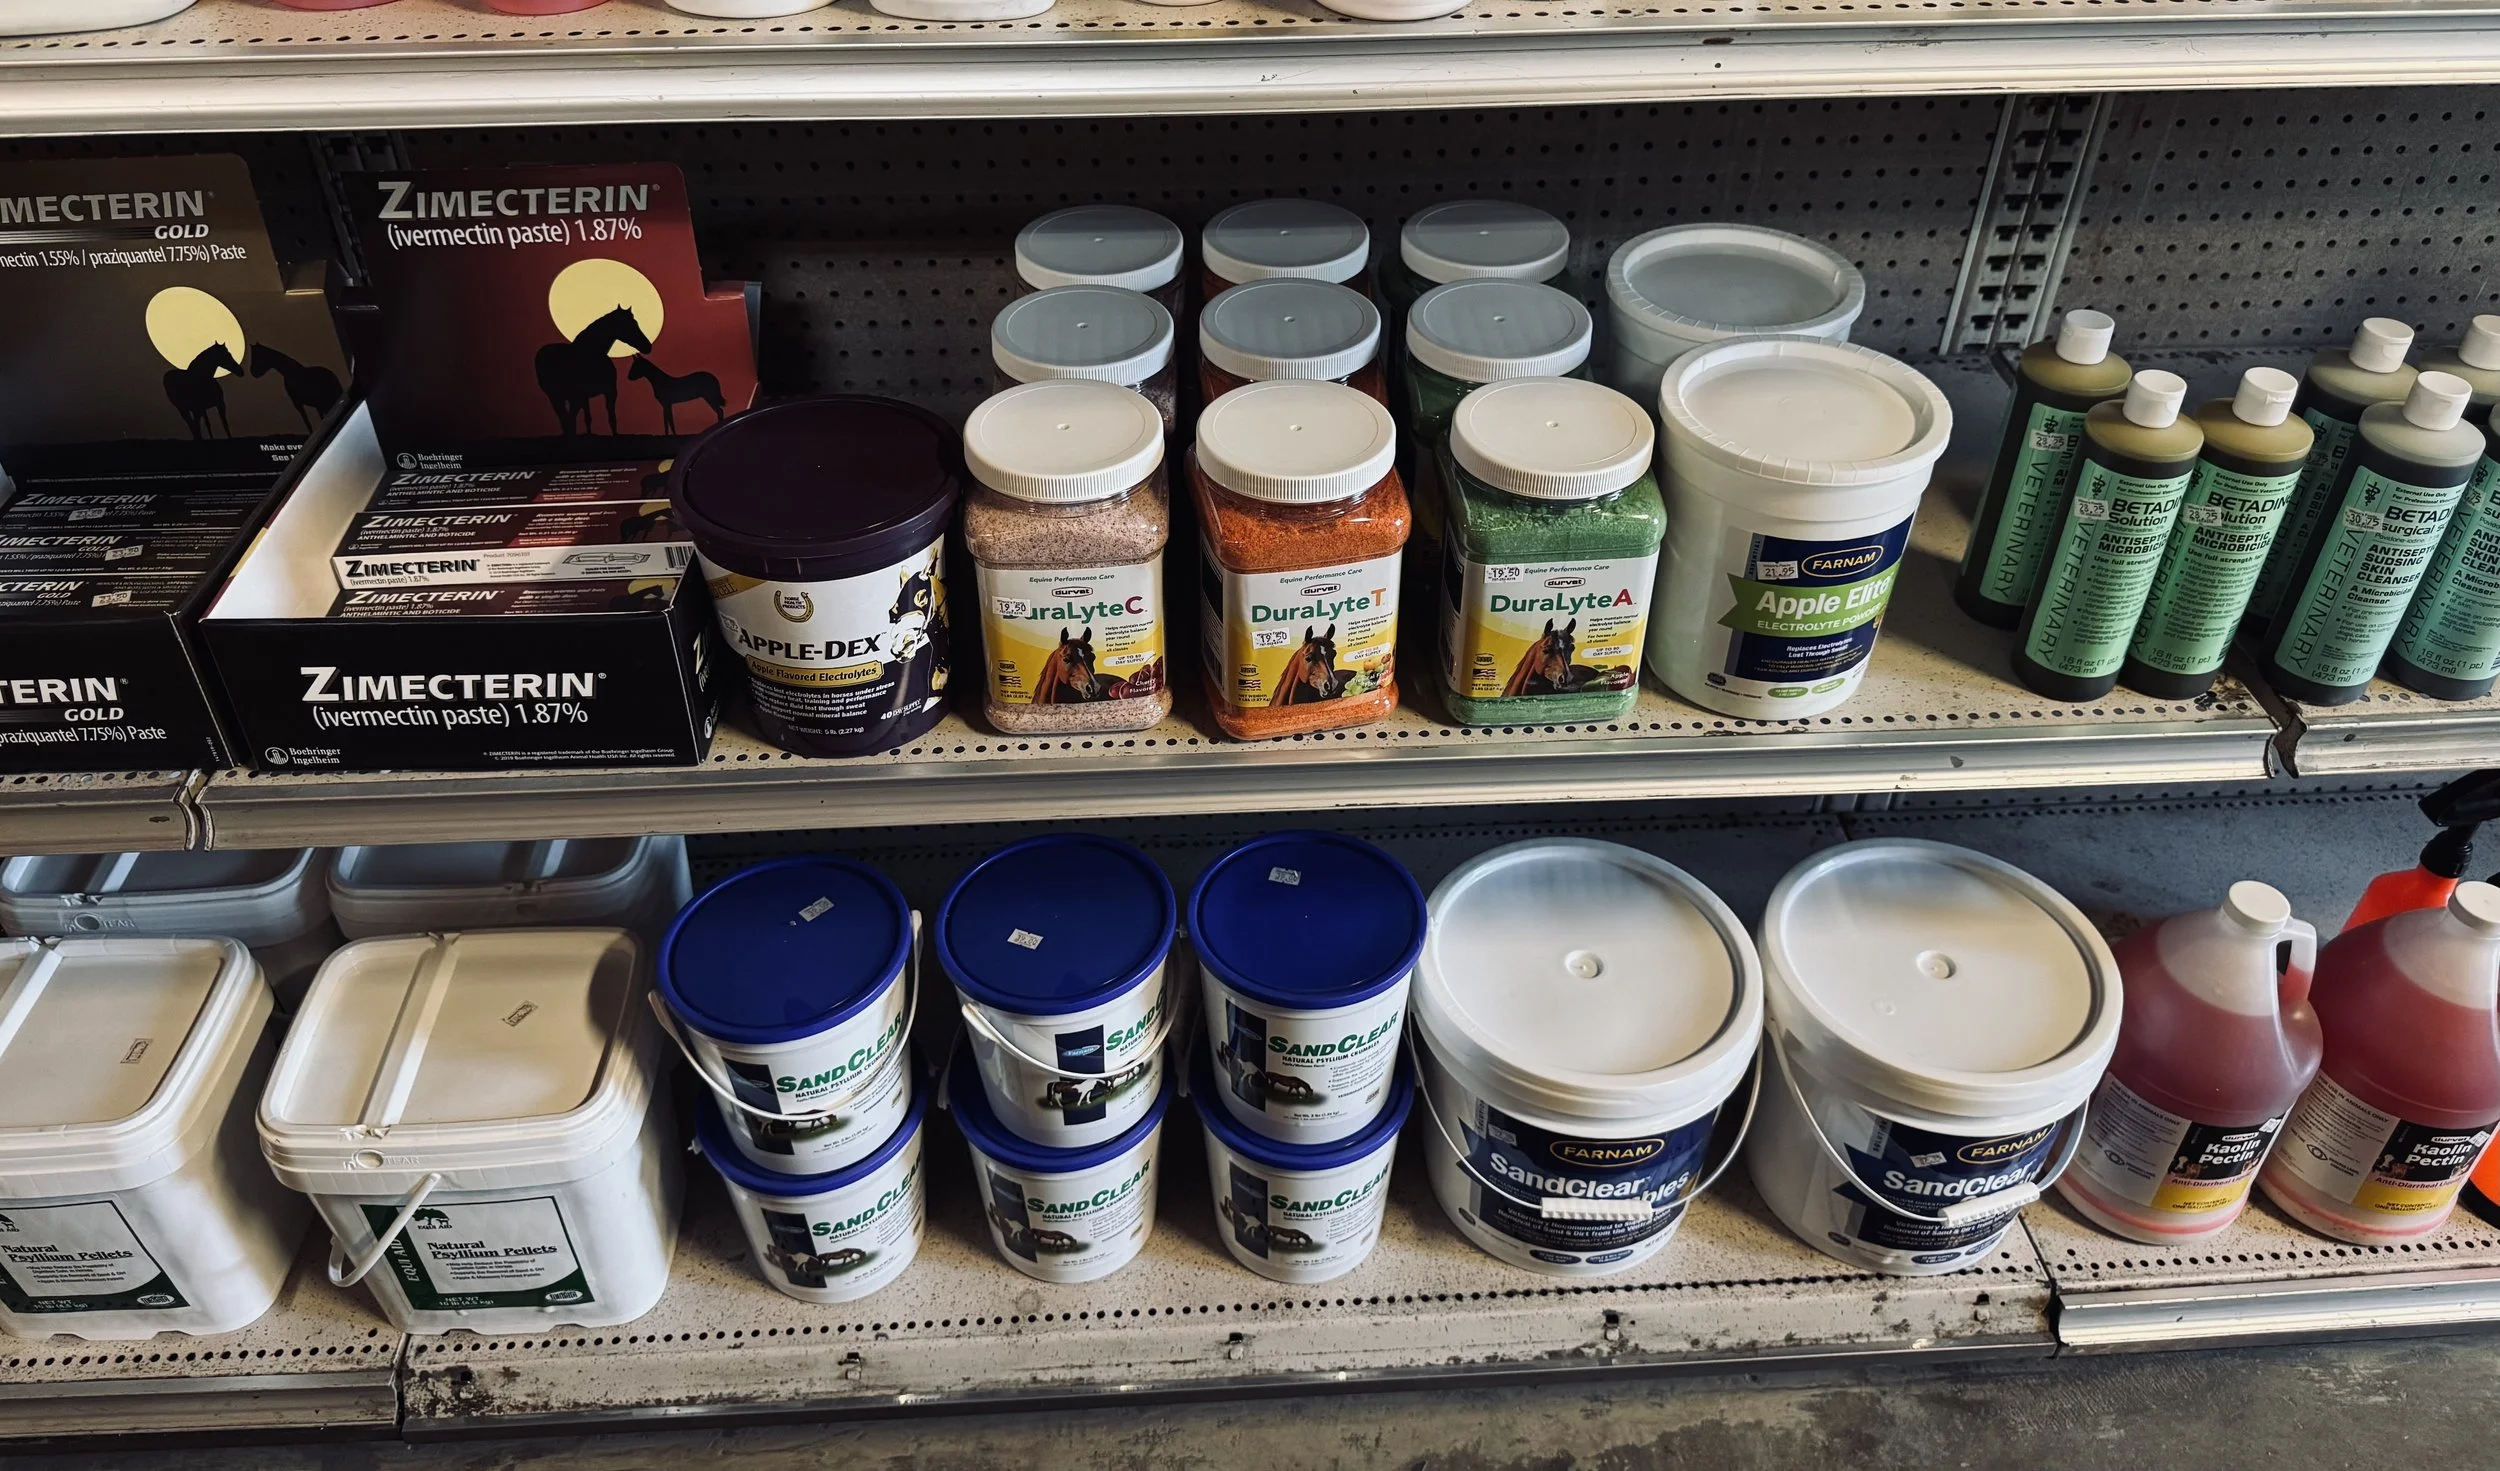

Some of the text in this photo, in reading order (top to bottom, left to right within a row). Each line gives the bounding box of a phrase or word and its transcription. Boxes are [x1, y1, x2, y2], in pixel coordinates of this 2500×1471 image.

[154, 224, 209, 240] GOLD
[387, 216, 643, 250] (ivermectin paste) 1.87%
[39, 244, 248, 269] 1.55% praziquantel 7.75%) Paste
[417, 453, 463, 462] Boehringer
[420, 462, 463, 470] Ingelheim
[2216, 472, 2241, 484] External
[2224, 483, 2259, 494] Professional
[2395, 486, 2422, 497] External
[2108, 512, 2168, 526] Solution
[357, 533, 418, 541] ANTHELMINTIC
[1994, 462, 2049, 600] VETERINARY
[2101, 530, 2170, 546] ANTISEPTIC
[2195, 525, 2270, 543] ANTISEPTIC
[2191, 534, 2272, 552] MICROBICIDE
[1811, 551, 1878, 571] FARNAM
[2204, 552, 2218, 561] full
[2364, 552, 2424, 567] SUDSING
[2465, 547, 2499, 566] SKIN
[1524, 567, 1549, 575] Equine
[1549, 565, 1593, 573] Performance
[2360, 562, 2396, 576] SKIN
[1029, 576, 1053, 584] Equine
[1054, 574, 1098, 584] Performance
[1279, 576, 1303, 584] Equine
[1304, 571, 1346, 582] Performance
[1547, 579, 1582, 587] durvet
[2356, 570, 2422, 585] CLEANSER
[2400, 511, 2471, 655] VETERINARY
[1304, 585, 1339, 595] durvet
[2038, 520, 2095, 662] VETERINARY
[2451, 577, 2496, 597] Cleanser
[1755, 574, 1893, 620] Apple Elite
[2289, 529, 2362, 671] VETERINARY
[2347, 592, 2391, 605] Cleanser
[1756, 602, 1883, 632] ELECTROLYTE POWDER
[739, 628, 881, 661] APPLE-DEX
[2062, 655, 2076, 665] 16
[2421, 648, 2435, 659] 16
[2444, 656, 2456, 667] oz
[752, 660, 877, 682] Apple Flavored Electrolytes
[2316, 663, 2330, 673] 16
[831, 681, 895, 699] horses under stress
[845, 689, 887, 703] performance
[64, 707, 125, 722] GOLD
[312, 701, 589, 731] (ivermectin paste) 1.87%
[78, 726, 127, 743] 7.75%)
[127, 725, 168, 741] Paste
[289, 746, 341, 757] Boehringer
[292, 755, 341, 766] Ingelheim
[1281, 1039, 1380, 1064] NATURAL PSYLLIUM CRUMBLES
[795, 1085, 830, 1099] NATURAL
[830, 1069, 863, 1089] PSYLLIUM
[1970, 1128, 2049, 1157] FARNAM
[2205, 1138, 2261, 1155] Kaolin
[2413, 1143, 2473, 1157] Kaolin
[1563, 1145, 1654, 1160] FARNAM
[2199, 1150, 2254, 1165] Pectin
[2406, 1153, 2467, 1167] Pectin
[1490, 1151, 1645, 1198] SandClear
[1883, 1161, 2029, 1197] SandClear
[2171, 1178, 2231, 1188] Anti-Diarrheal
[2375, 1176, 2439, 1190] Anti-Diarrheal
[1042, 1212, 1073, 1221] NATURAL
[1073, 1205, 1105, 1220] PSYLLIUM
[1283, 1210, 1315, 1219] NATURAL
[1314, 1206, 1345, 1218] PSYLLIUM
[829, 1209, 889, 1241] NATURAL PSYLLIUM
[1543, 1225, 1564, 1236] Sand
[1, 1244, 59, 1253] Natural
[426, 1240, 486, 1250] Natural
[432, 1243, 558, 1260] Psyllium Pellets
[9, 1249, 134, 1262] Psyllium Pellets
[400, 1260, 420, 1283] EQUI
